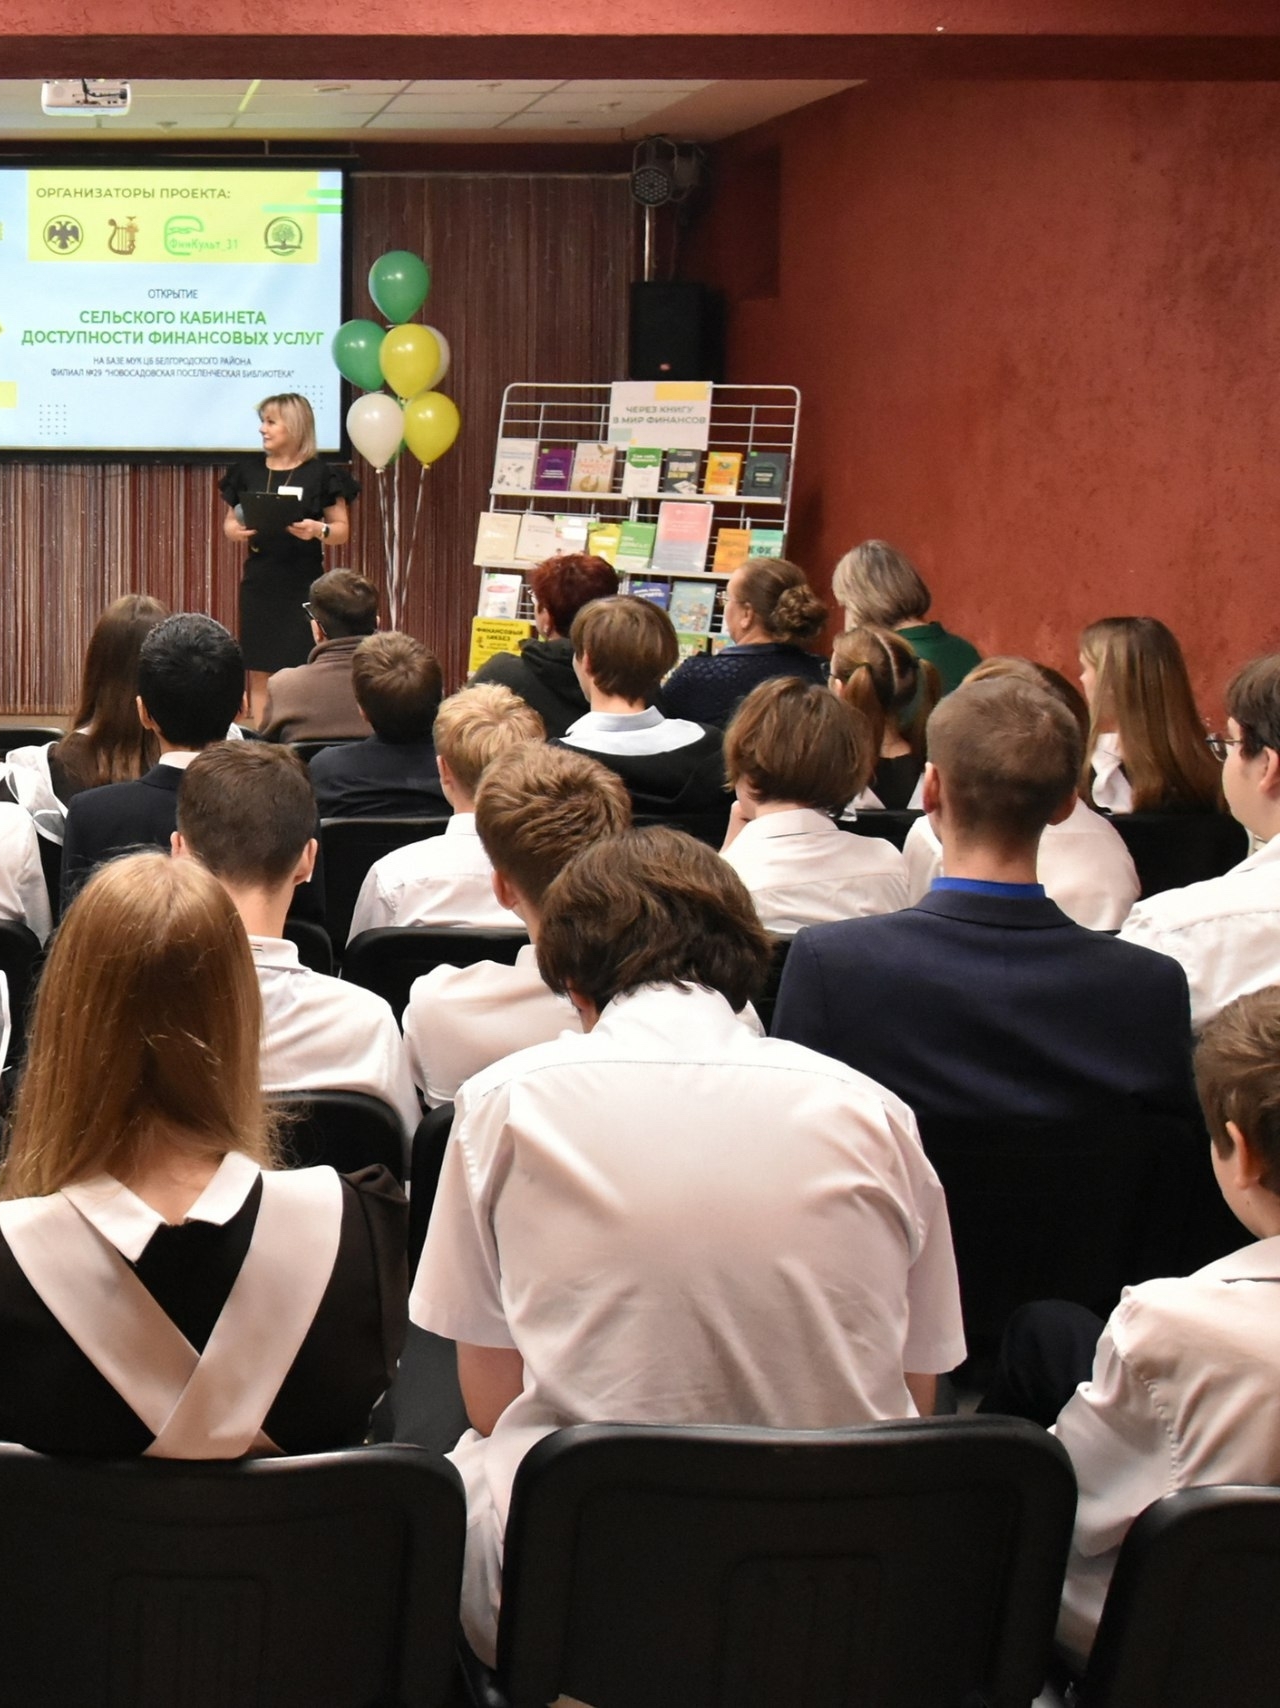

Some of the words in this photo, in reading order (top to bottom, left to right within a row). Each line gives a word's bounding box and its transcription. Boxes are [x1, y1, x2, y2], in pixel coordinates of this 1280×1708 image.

[36, 187, 155, 199] ОРГАНИЗАТОРЫ
[160, 188, 231, 199] ПРОЕКТА:
[148, 289, 199, 299] ОТКРЫТИЕ
[79, 310, 175, 324] СЕЛЬСКОГО
[180, 311, 267, 325] КАБИНЕТА
[21, 330, 143, 346] ДОСТУПНОСТИ
[148, 331, 269, 345] ФИНАНСОВЫХ
[273, 331, 324, 346] УСЛУГ
[93, 356, 104, 365] НА
[106, 356, 124, 365] БАЗЕ
[126, 356, 142, 365] МУК
[143, 357, 154, 366] ЦБ
[155, 357, 218, 366] БЕЛГОРОДСКОГО
[220, 355, 252, 366] РАЙОНА
[51, 368, 84, 377] ФИЛИАЛ
[177, 369, 241, 378] ПОСЕЛЕНЧЕСКАЯ
[626, 406, 657, 414] ЧЕРЕЗ
[660, 406, 694, 414] КНИГУ
[613, 416, 620, 424] В
[622, 416, 644, 424] МИР
[646, 416, 707, 424] ФИНАНСОВ
